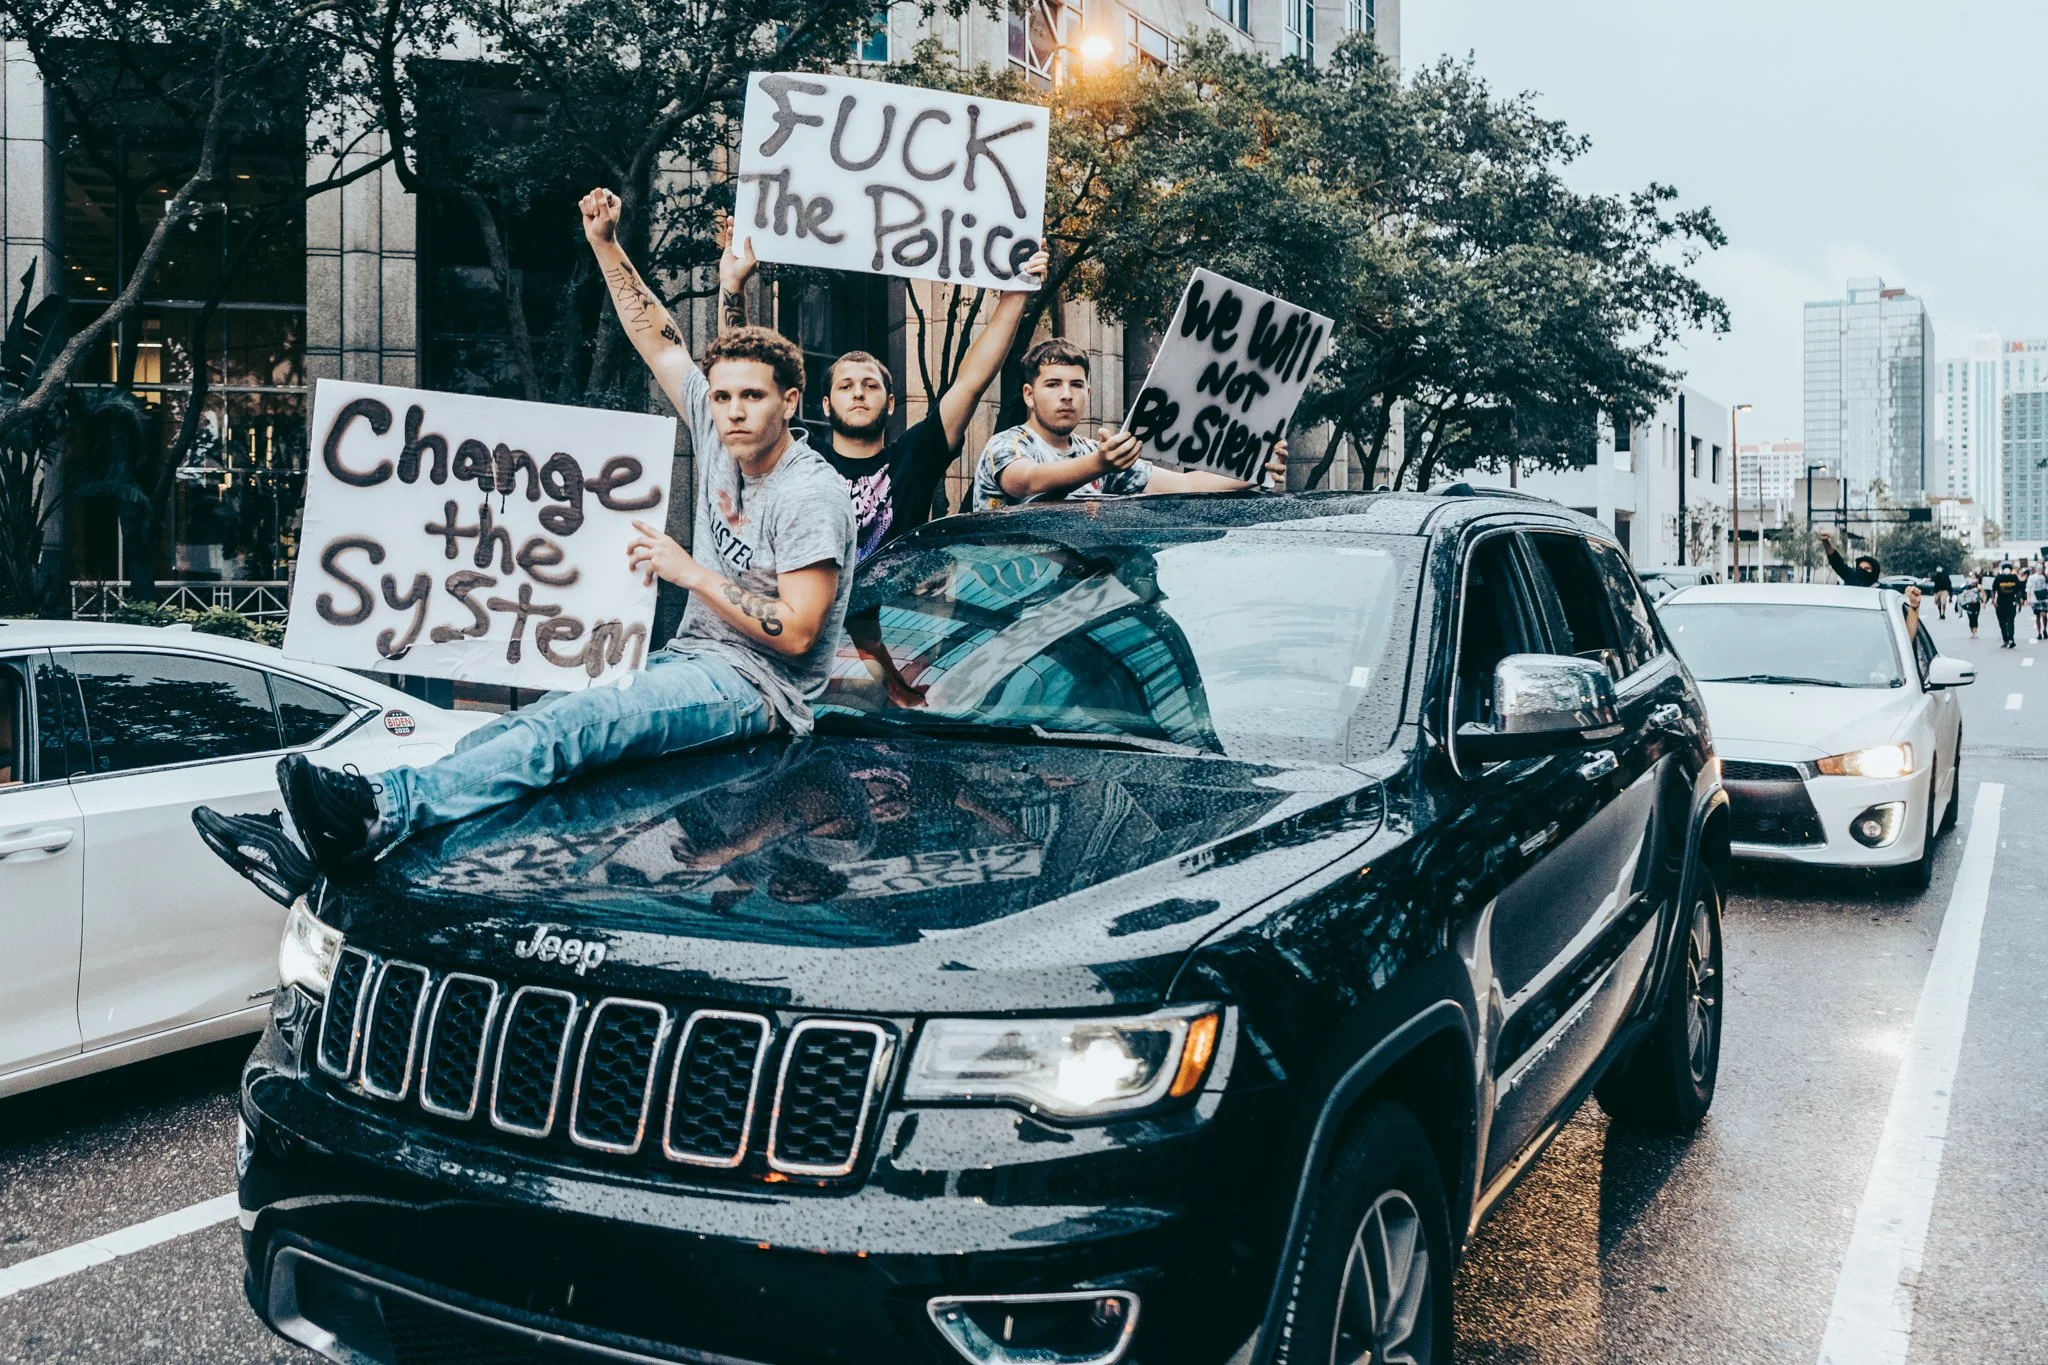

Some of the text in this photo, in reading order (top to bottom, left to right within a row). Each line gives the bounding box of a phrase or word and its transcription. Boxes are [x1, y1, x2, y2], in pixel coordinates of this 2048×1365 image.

[758, 75, 1035, 219] FUCK
[739, 168, 1041, 280] The Police
[1128, 387, 1286, 485] Be Silent
[1196, 361, 1270, 413] NOT
[323, 398, 663, 536] Change
[424, 500, 580, 588] the
[315, 534, 648, 681] System
[386, 717, 413, 728] BIDEN
[515, 925, 606, 976] Jeep
